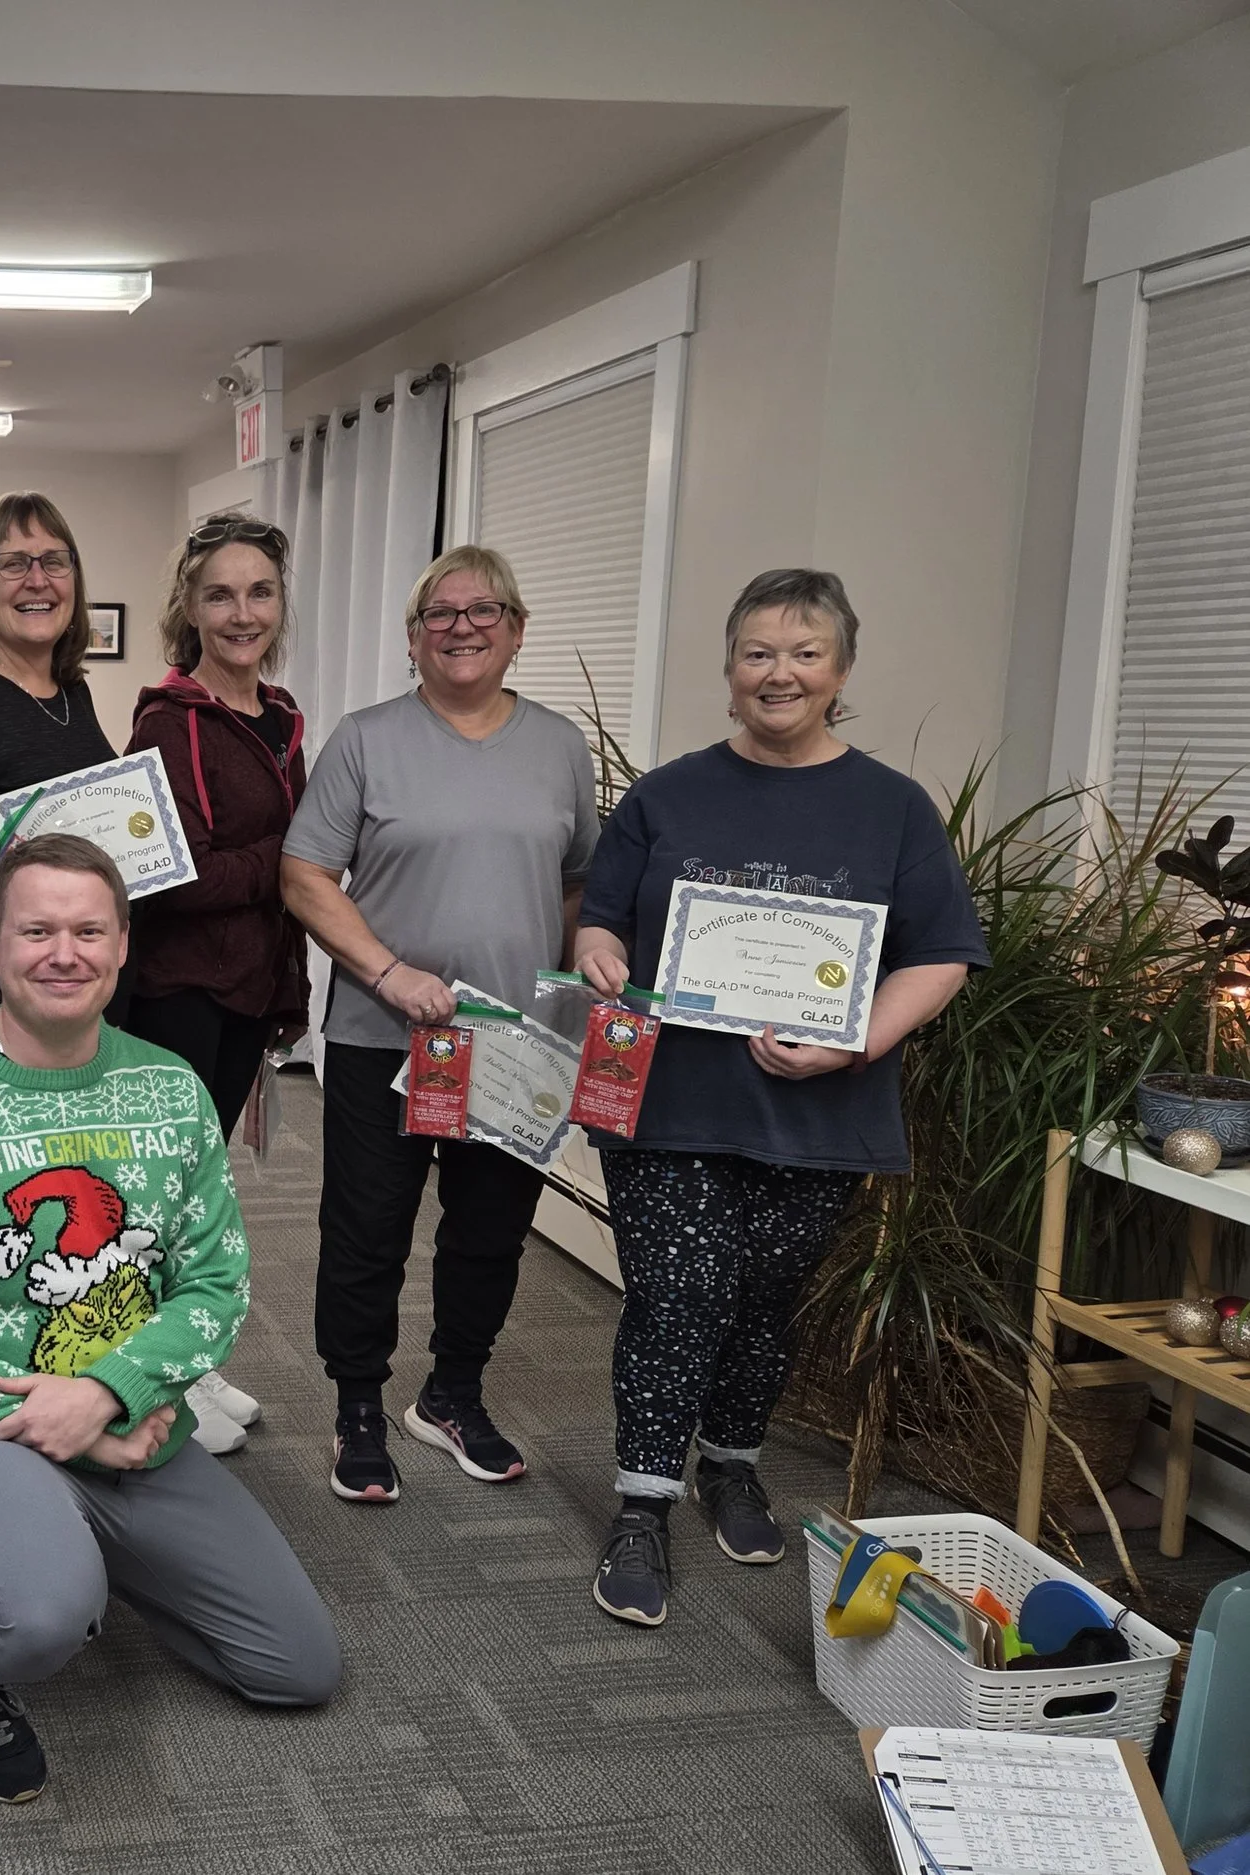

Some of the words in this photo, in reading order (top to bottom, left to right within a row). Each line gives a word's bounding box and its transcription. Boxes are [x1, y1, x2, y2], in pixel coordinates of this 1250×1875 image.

[241, 402, 261, 463] EXIT
[27, 796, 67, 841] ertificate
[69, 790, 81, 802] of
[84, 785, 153, 806] Completion
[127, 842, 165, 860] Program
[137, 856, 172, 875] GLA:D
[688, 911, 758, 941] Certificate
[763, 911, 778, 921] of
[781, 912, 855, 959] Completion
[681, 976, 701, 987] The
[753, 986, 794, 999] Canada
[797, 991, 844, 1007] Program
[801, 1010, 843, 1026] GLA:D
[462, 1020, 512, 1037] tificate
[516, 1031, 529, 1042] of
[530, 1038, 575, 1098] Completion
[483, 1088, 515, 1112] Canada
[515, 1106, 551, 1133] Program
[45, 1130, 133, 1165] GRINCH
[131, 1126, 179, 1159] FAC
[512, 1124, 544, 1146] GLA:D
